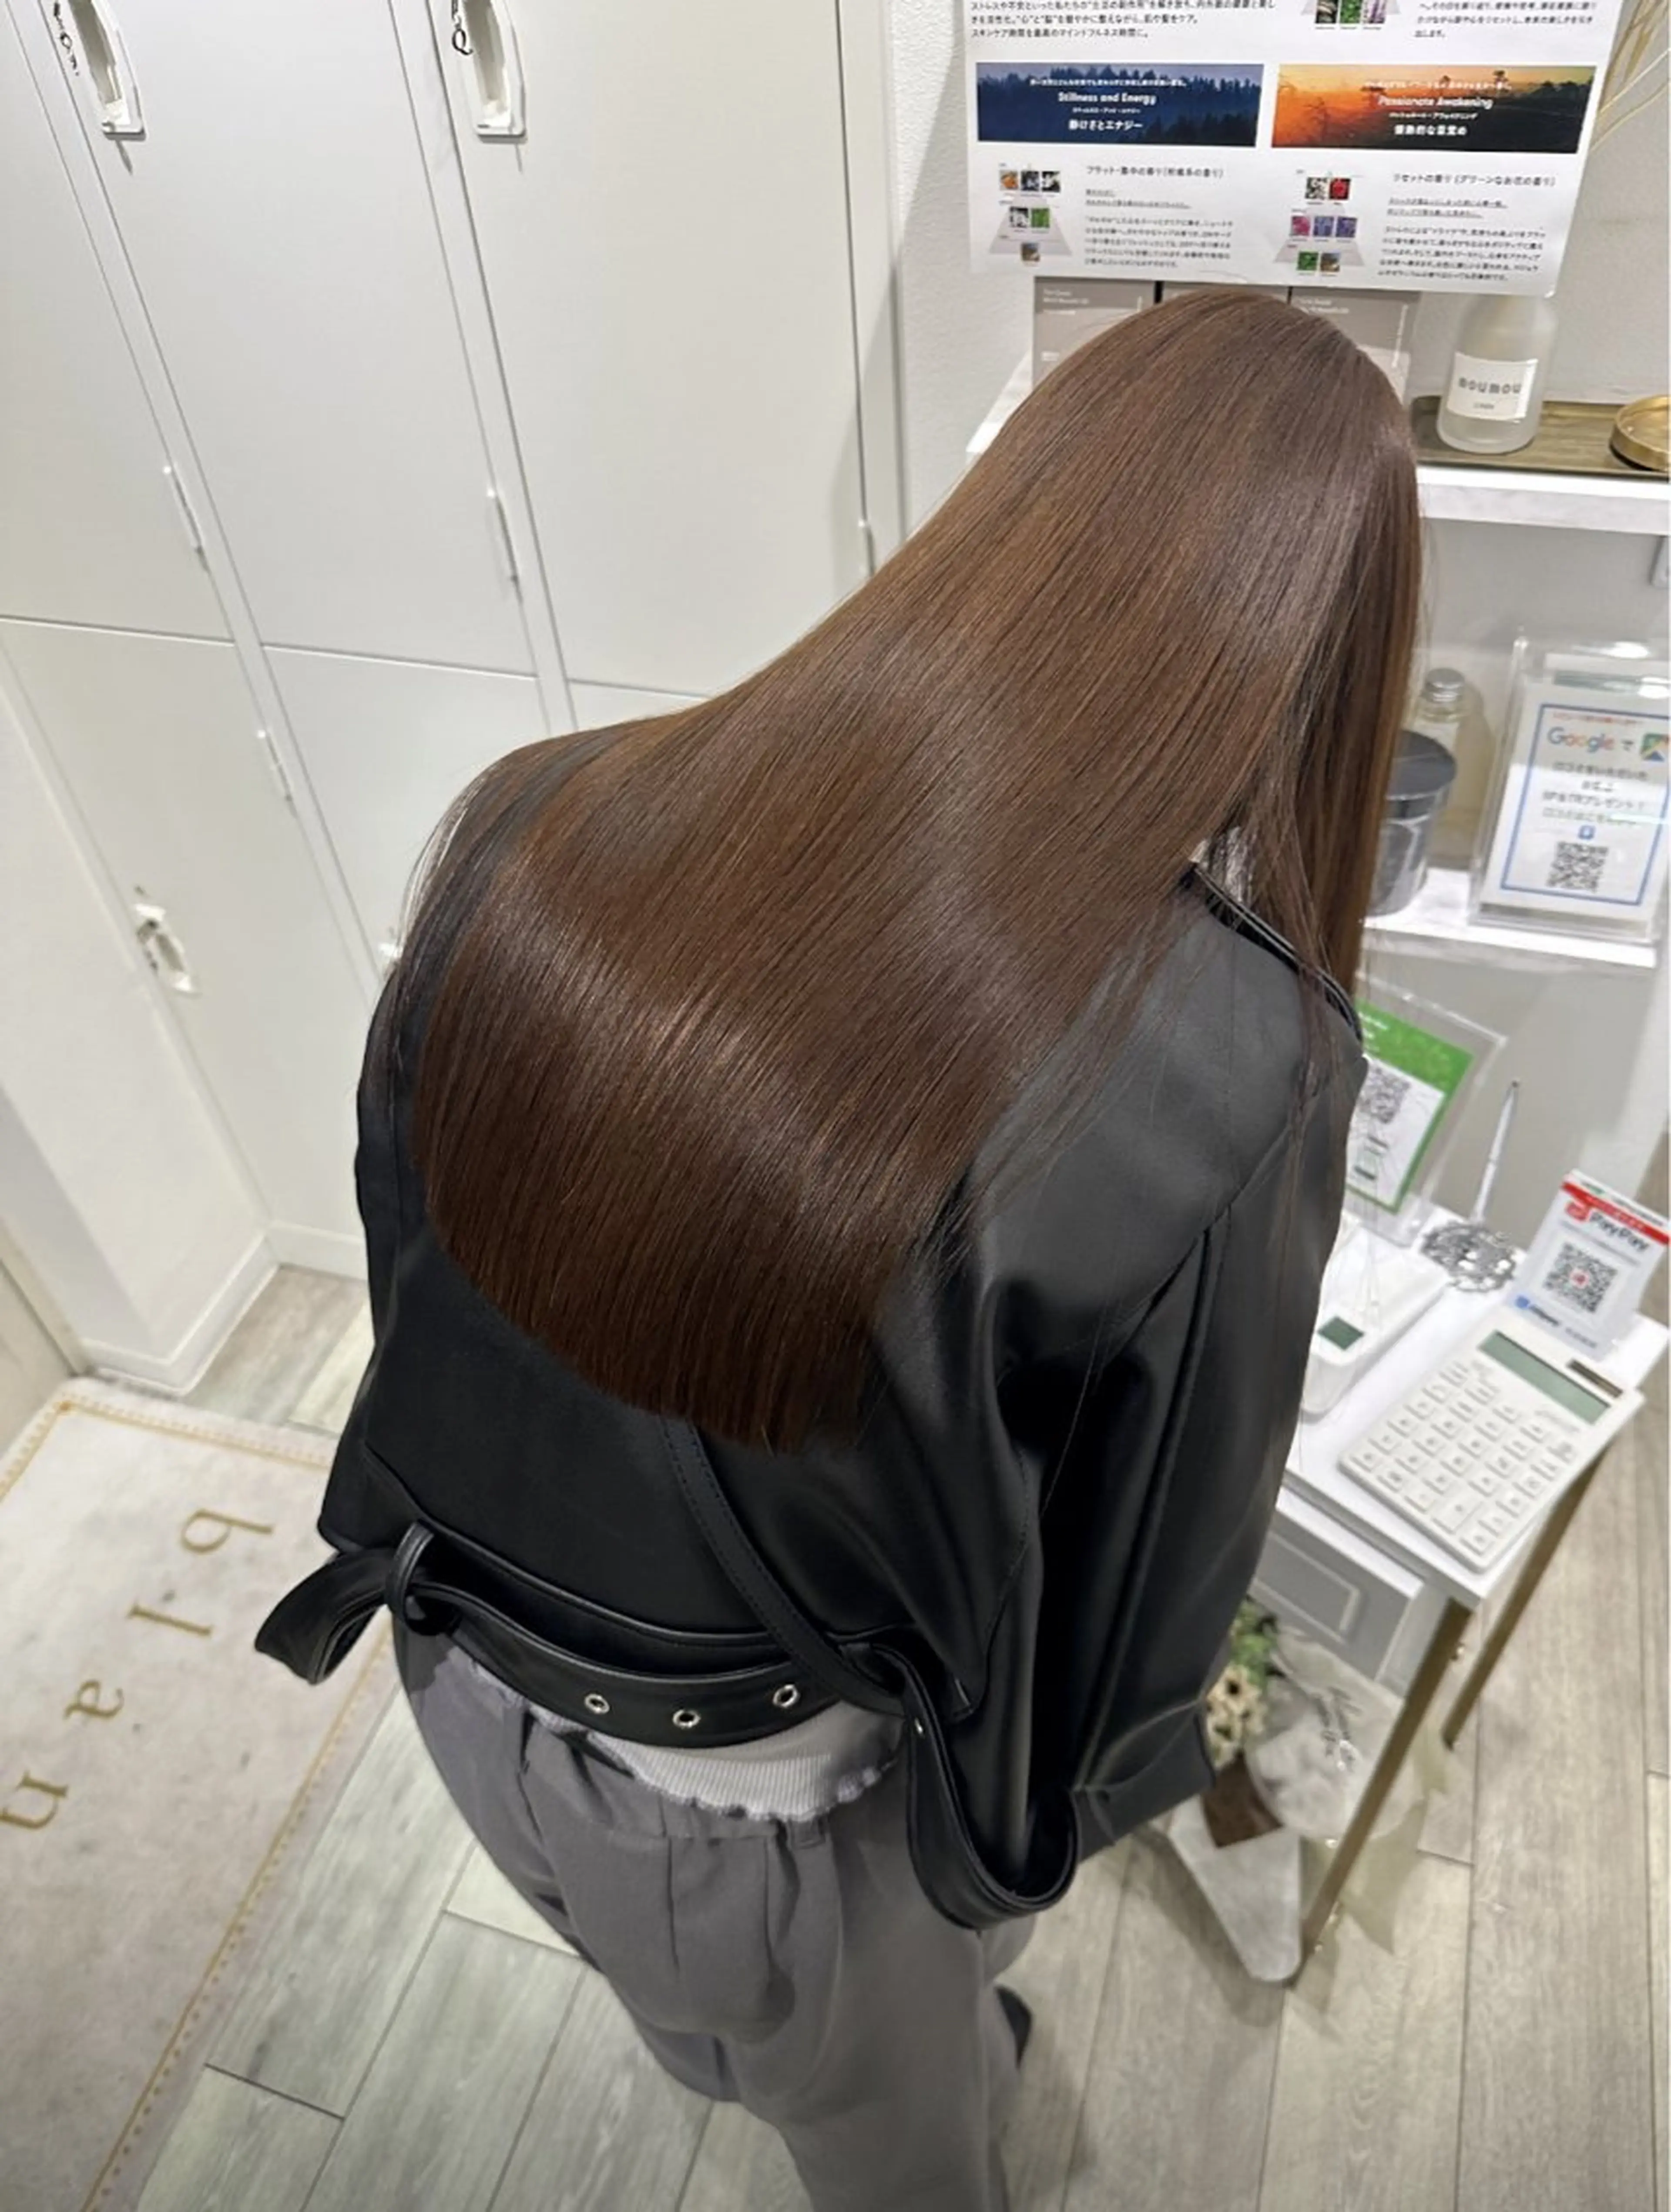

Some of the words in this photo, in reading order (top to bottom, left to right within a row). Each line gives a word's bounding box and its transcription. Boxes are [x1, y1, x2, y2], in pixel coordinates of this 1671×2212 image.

[1058, 92, 1097, 102] Stillness
[1101, 93, 1119, 102] and
[1121, 93, 1157, 105] Energy
[1378, 96, 1434, 106] Passionate
[1436, 96, 1493, 110] Awakening
[1548, 727, 1614, 753] Google
[1591, 1212, 1649, 1251] PayPay
